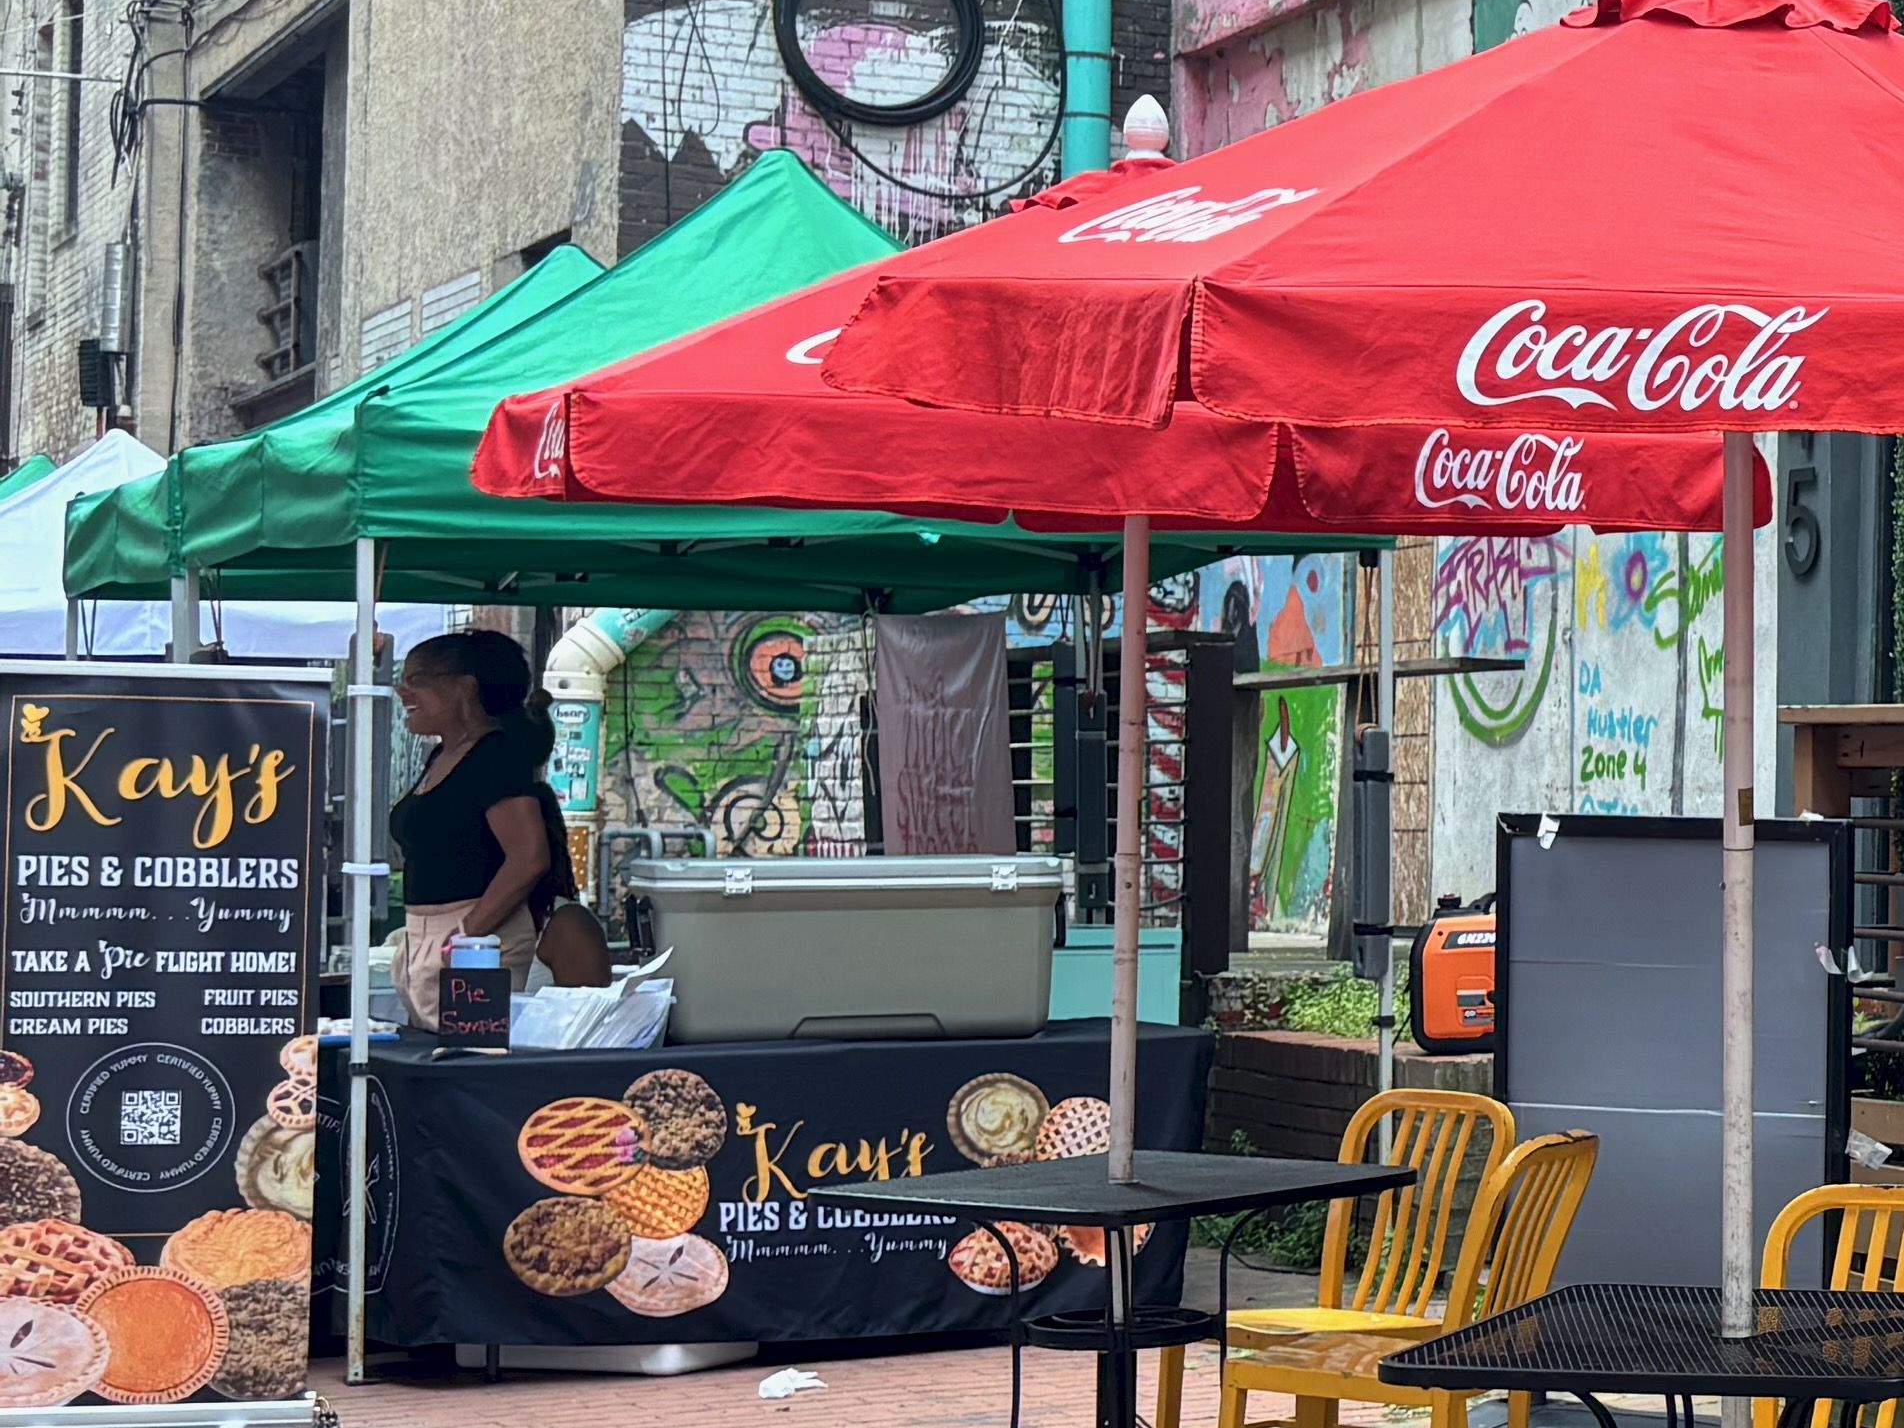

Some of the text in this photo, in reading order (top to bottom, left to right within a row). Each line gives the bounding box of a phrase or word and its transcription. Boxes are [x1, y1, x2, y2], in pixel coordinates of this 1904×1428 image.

[1456, 300, 1830, 411] Coca-Cola
[1414, 429, 1586, 511] Coca-Cola
[23, 726, 296, 850] Kay's
[17, 855, 299, 890] PIES & COBBLERS
[12, 940, 296, 981] TAKE A Pie FLIGHT HOME!
[10, 991, 156, 1009] SOUTHERN PIES
[203, 989, 298, 1007] FRUIT PIES
[452, 979, 490, 1004] Pie
[10, 1019, 128, 1035] CREAM PIES
[201, 1018, 295, 1035] COBBLERS
[736, 1120, 934, 1204] Kay's
[719, 1201, 779, 1232] PIES
[789, 1201, 808, 1230] &
